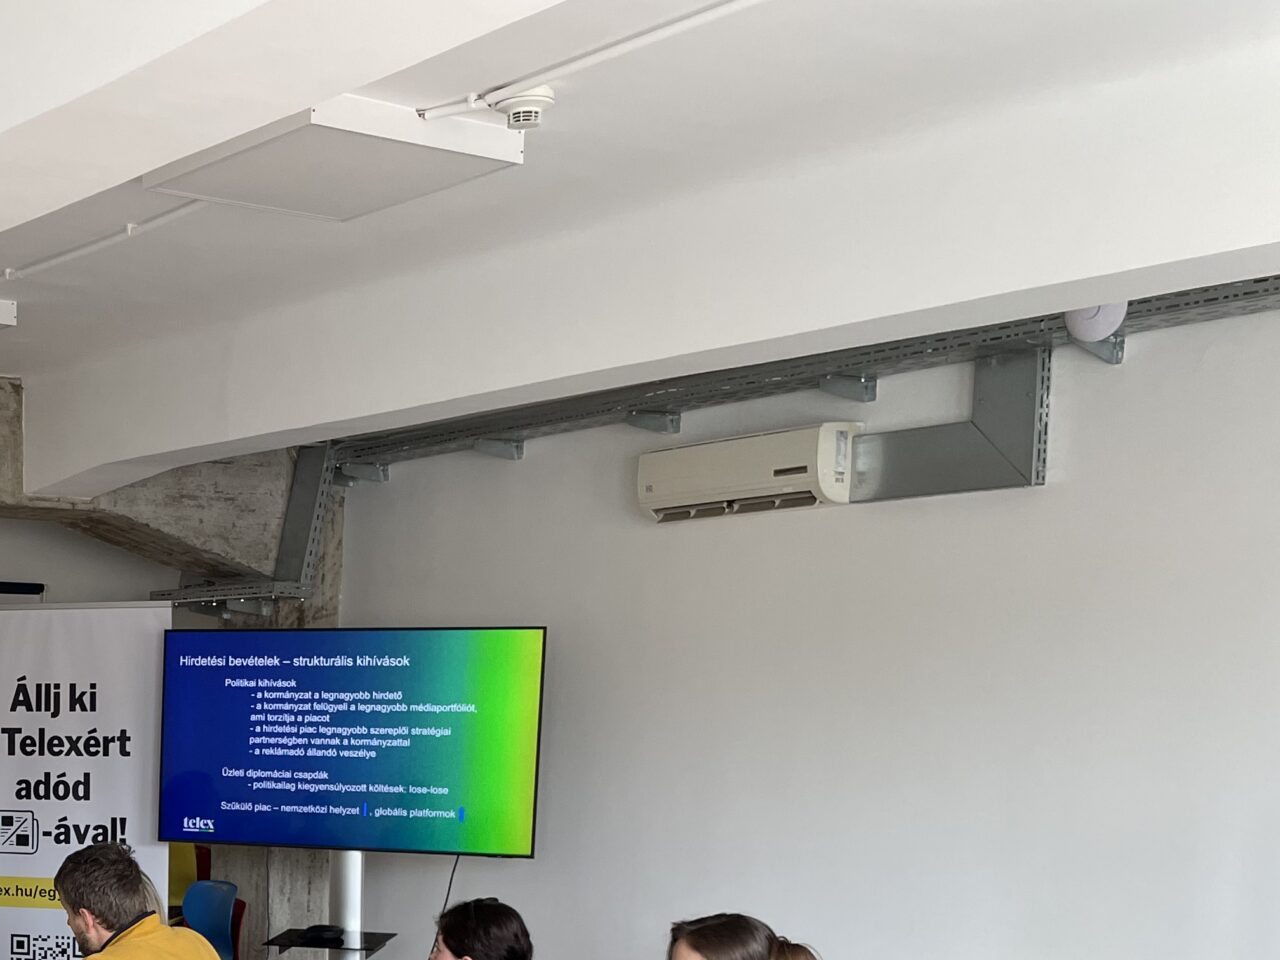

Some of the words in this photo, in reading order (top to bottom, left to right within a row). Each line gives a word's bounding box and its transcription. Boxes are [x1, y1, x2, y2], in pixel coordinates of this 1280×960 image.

[179, 655, 226, 667] Hirdetési
[228, 655, 280, 667] bevételek
[292, 656, 354, 667] strukturális
[356, 656, 410, 667] kihívások
[225, 679, 256, 688] Politikai
[258, 679, 297, 688] kihívások
[10, 675, 61, 718] Állj
[69, 683, 97, 712] ki
[263, 690, 312, 701] kormányzat
[321, 691, 371, 702] legnagyobb
[372, 691, 403, 700] hirdető
[263, 702, 312, 712] kormányzat
[313, 702, 348, 713] felügyeli
[357, 703, 408, 713] legnagyobb
[250, 713, 265, 721] ami
[267, 713, 295, 723] torzítja
[297, 714, 302, 722] a
[304, 714, 330, 723] piacot
[255, 725, 261, 733] a
[262, 724, 298, 733] hirdetési
[299, 725, 318, 735] piac
[318, 725, 368, 736] legnagyobb
[370, 727, 409, 737] szereplői
[410, 727, 452, 738] stratégiai
[1, 727, 132, 758] Telexért
[249, 735, 308, 747] partnerségben
[310, 737, 341, 746] vannak
[342, 739, 348, 747] a
[350, 738, 411, 749] kormányzattal
[254, 747, 260, 755] a
[261, 746, 305, 757] reklámadó
[306, 748, 337, 757] állandó
[338, 749, 377, 760] veszélye
[221, 766, 245, 777] Üzleti
[246, 768, 292, 779] diplomáciai
[293, 770, 329, 780] csapdák
[15, 772, 91, 801] adód
[253, 780, 296, 792] politikailag
[297, 781, 367, 793] kiegyensúlyozott
[409, 785, 449, 795] lose-lose
[220, 801, 253, 811] Szűkülő
[254, 803, 272, 812] piac
[280, 803, 327, 814] nemzetközi
[329, 805, 360, 815] helyzet
[374, 807, 407, 818] globális
[409, 808, 456, 819] platformok
[182, 816, 215, 830] telex
